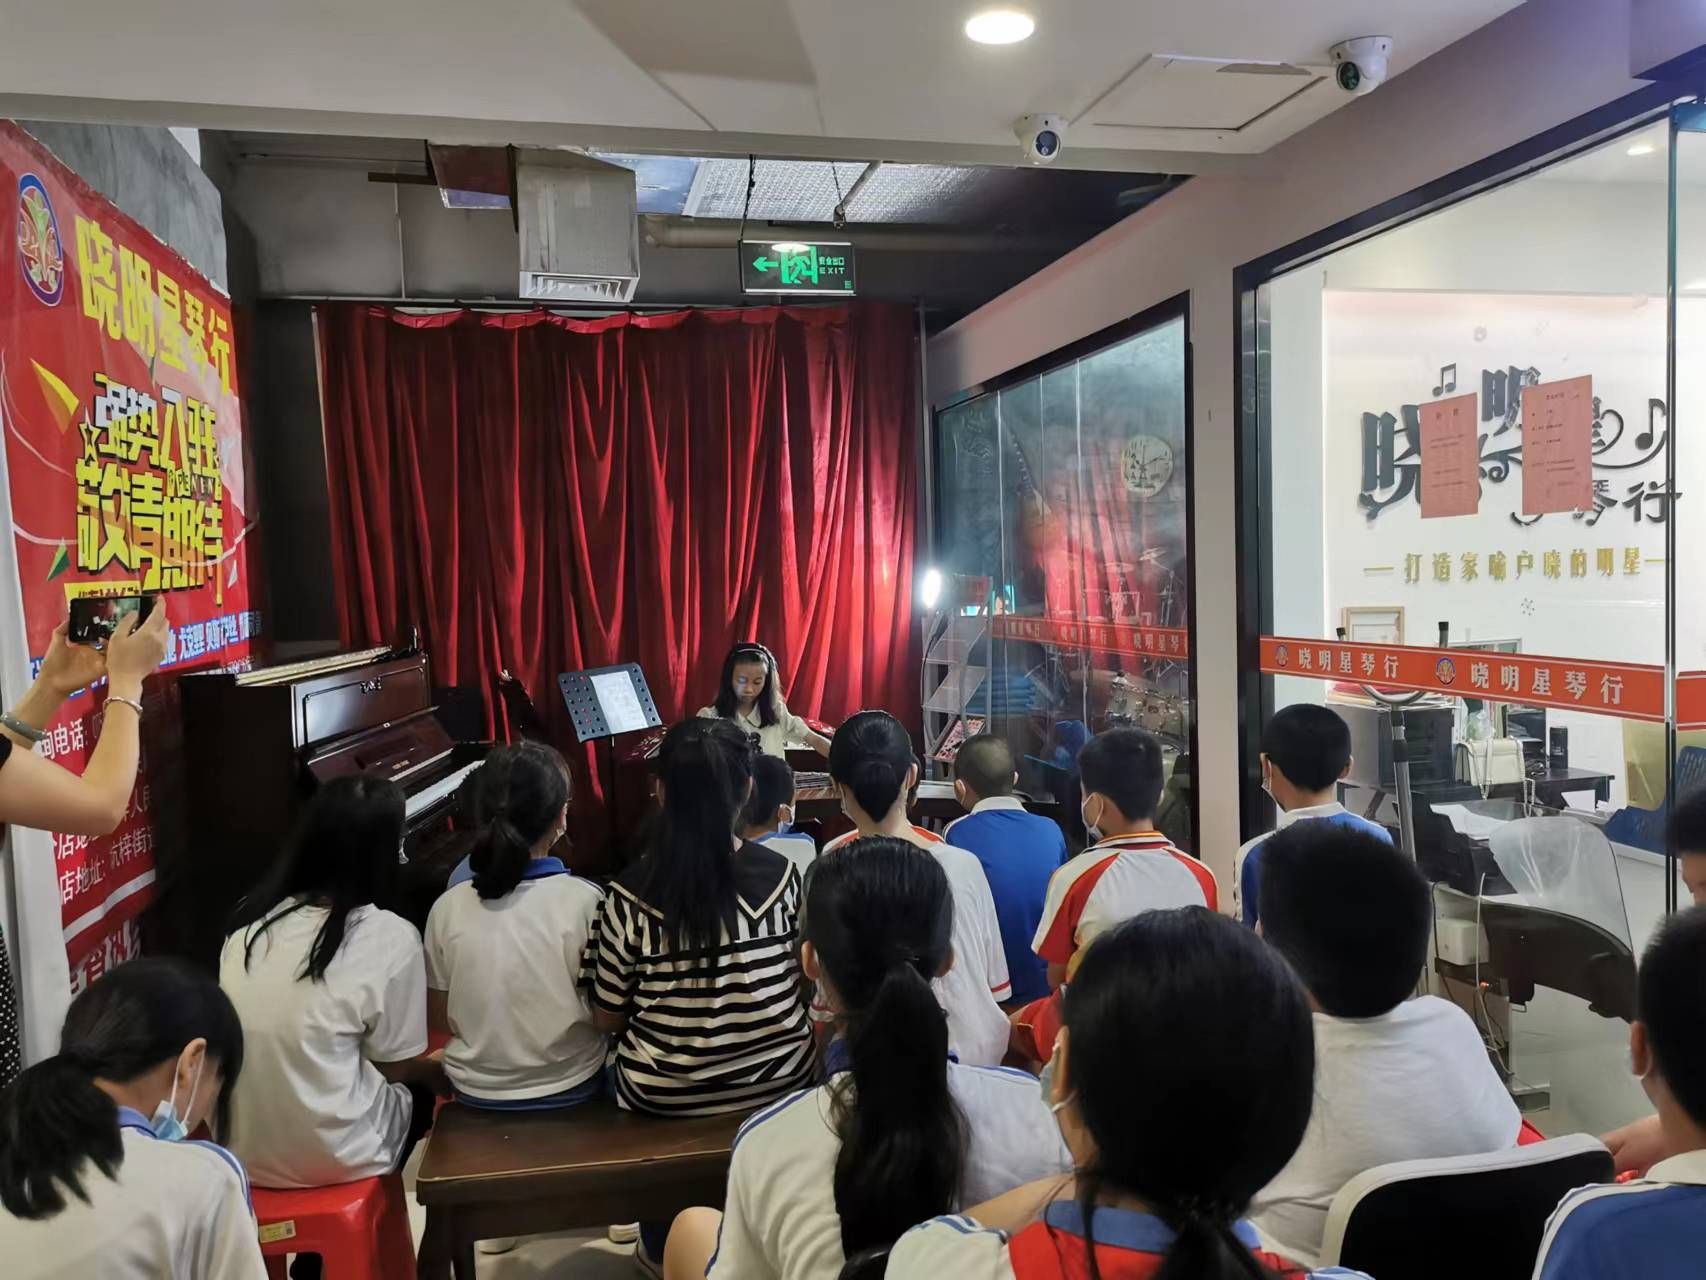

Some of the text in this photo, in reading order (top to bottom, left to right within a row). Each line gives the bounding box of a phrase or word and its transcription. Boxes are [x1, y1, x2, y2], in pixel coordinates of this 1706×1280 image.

[75, 215, 230, 396] 晓明星琴行
[1403, 547, 1641, 584] 打造家喻户晓的明星
[1133, 634, 1188, 656] 晓明星琴
[1299, 648, 1399, 679] 晓明星琴行
[1471, 662, 1624, 704] 晓明星琴行
